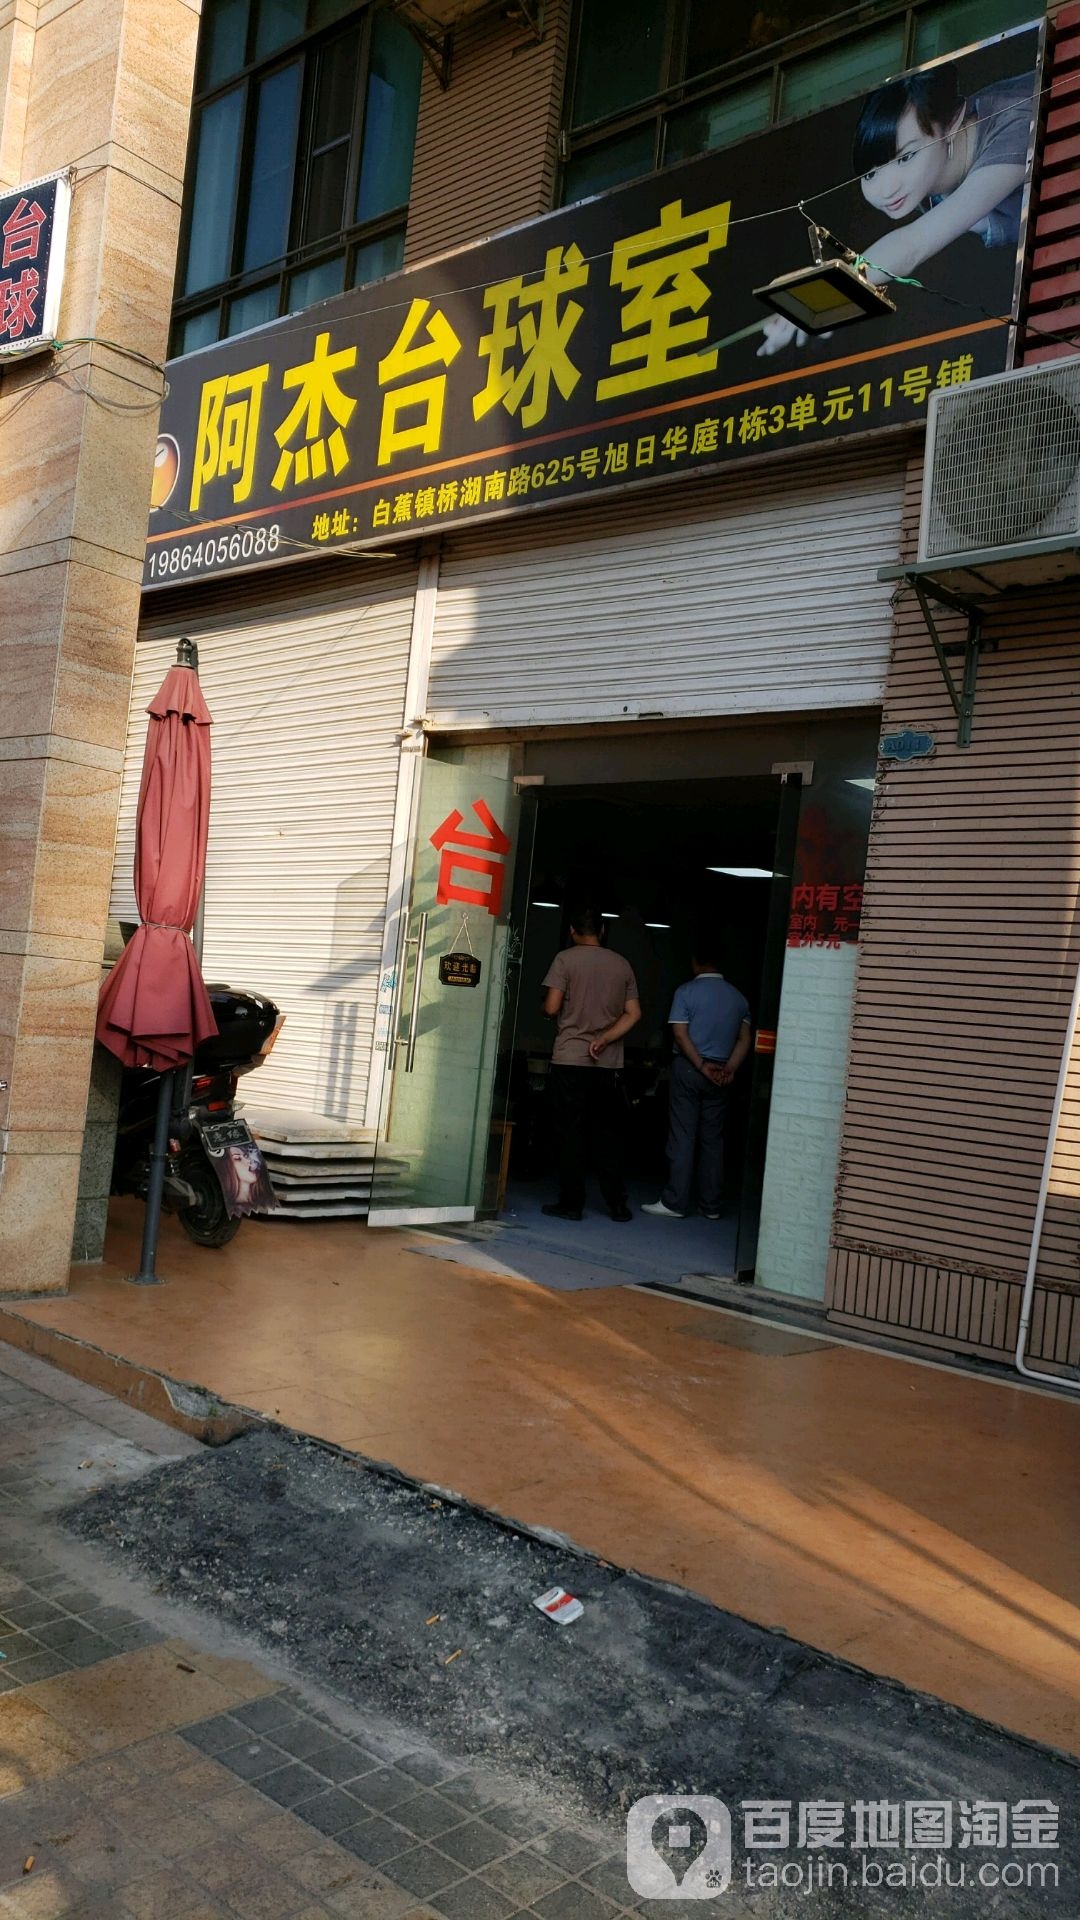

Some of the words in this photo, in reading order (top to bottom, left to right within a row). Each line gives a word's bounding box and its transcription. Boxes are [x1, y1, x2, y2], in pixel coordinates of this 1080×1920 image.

[0, 197, 47, 338] 台球
[189, 199, 731, 512] 阿杰台球室
[148, 524, 280, 578] 19864056088
